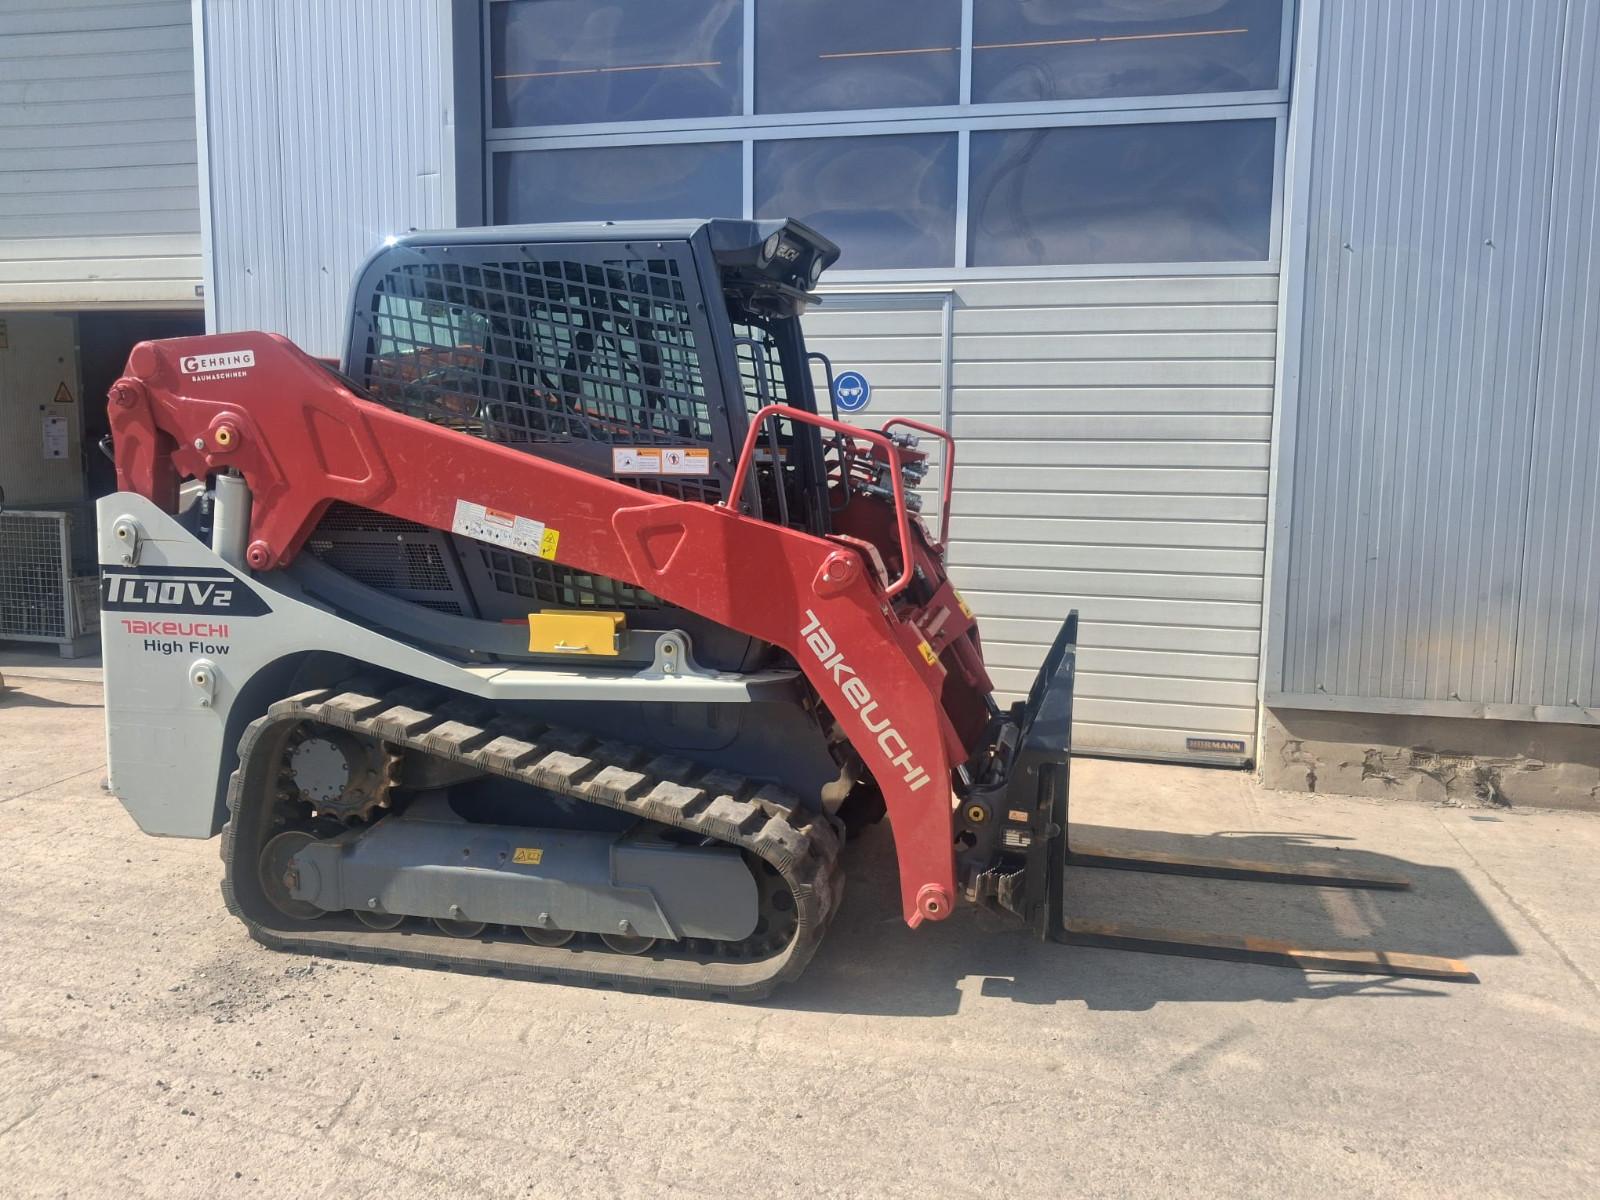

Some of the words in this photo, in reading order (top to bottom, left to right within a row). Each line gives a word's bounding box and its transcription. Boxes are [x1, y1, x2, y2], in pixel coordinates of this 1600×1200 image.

[184, 354, 251, 372] GEHRING
[191, 371, 247, 382] BAUMASCHINEN
[102, 571, 234, 607] TL10V2
[121, 619, 229, 638] TAKEUCHI
[144, 639, 183, 655] High
[189, 641, 230, 655] Flow
[800, 609, 931, 792] TAKEUCHI
